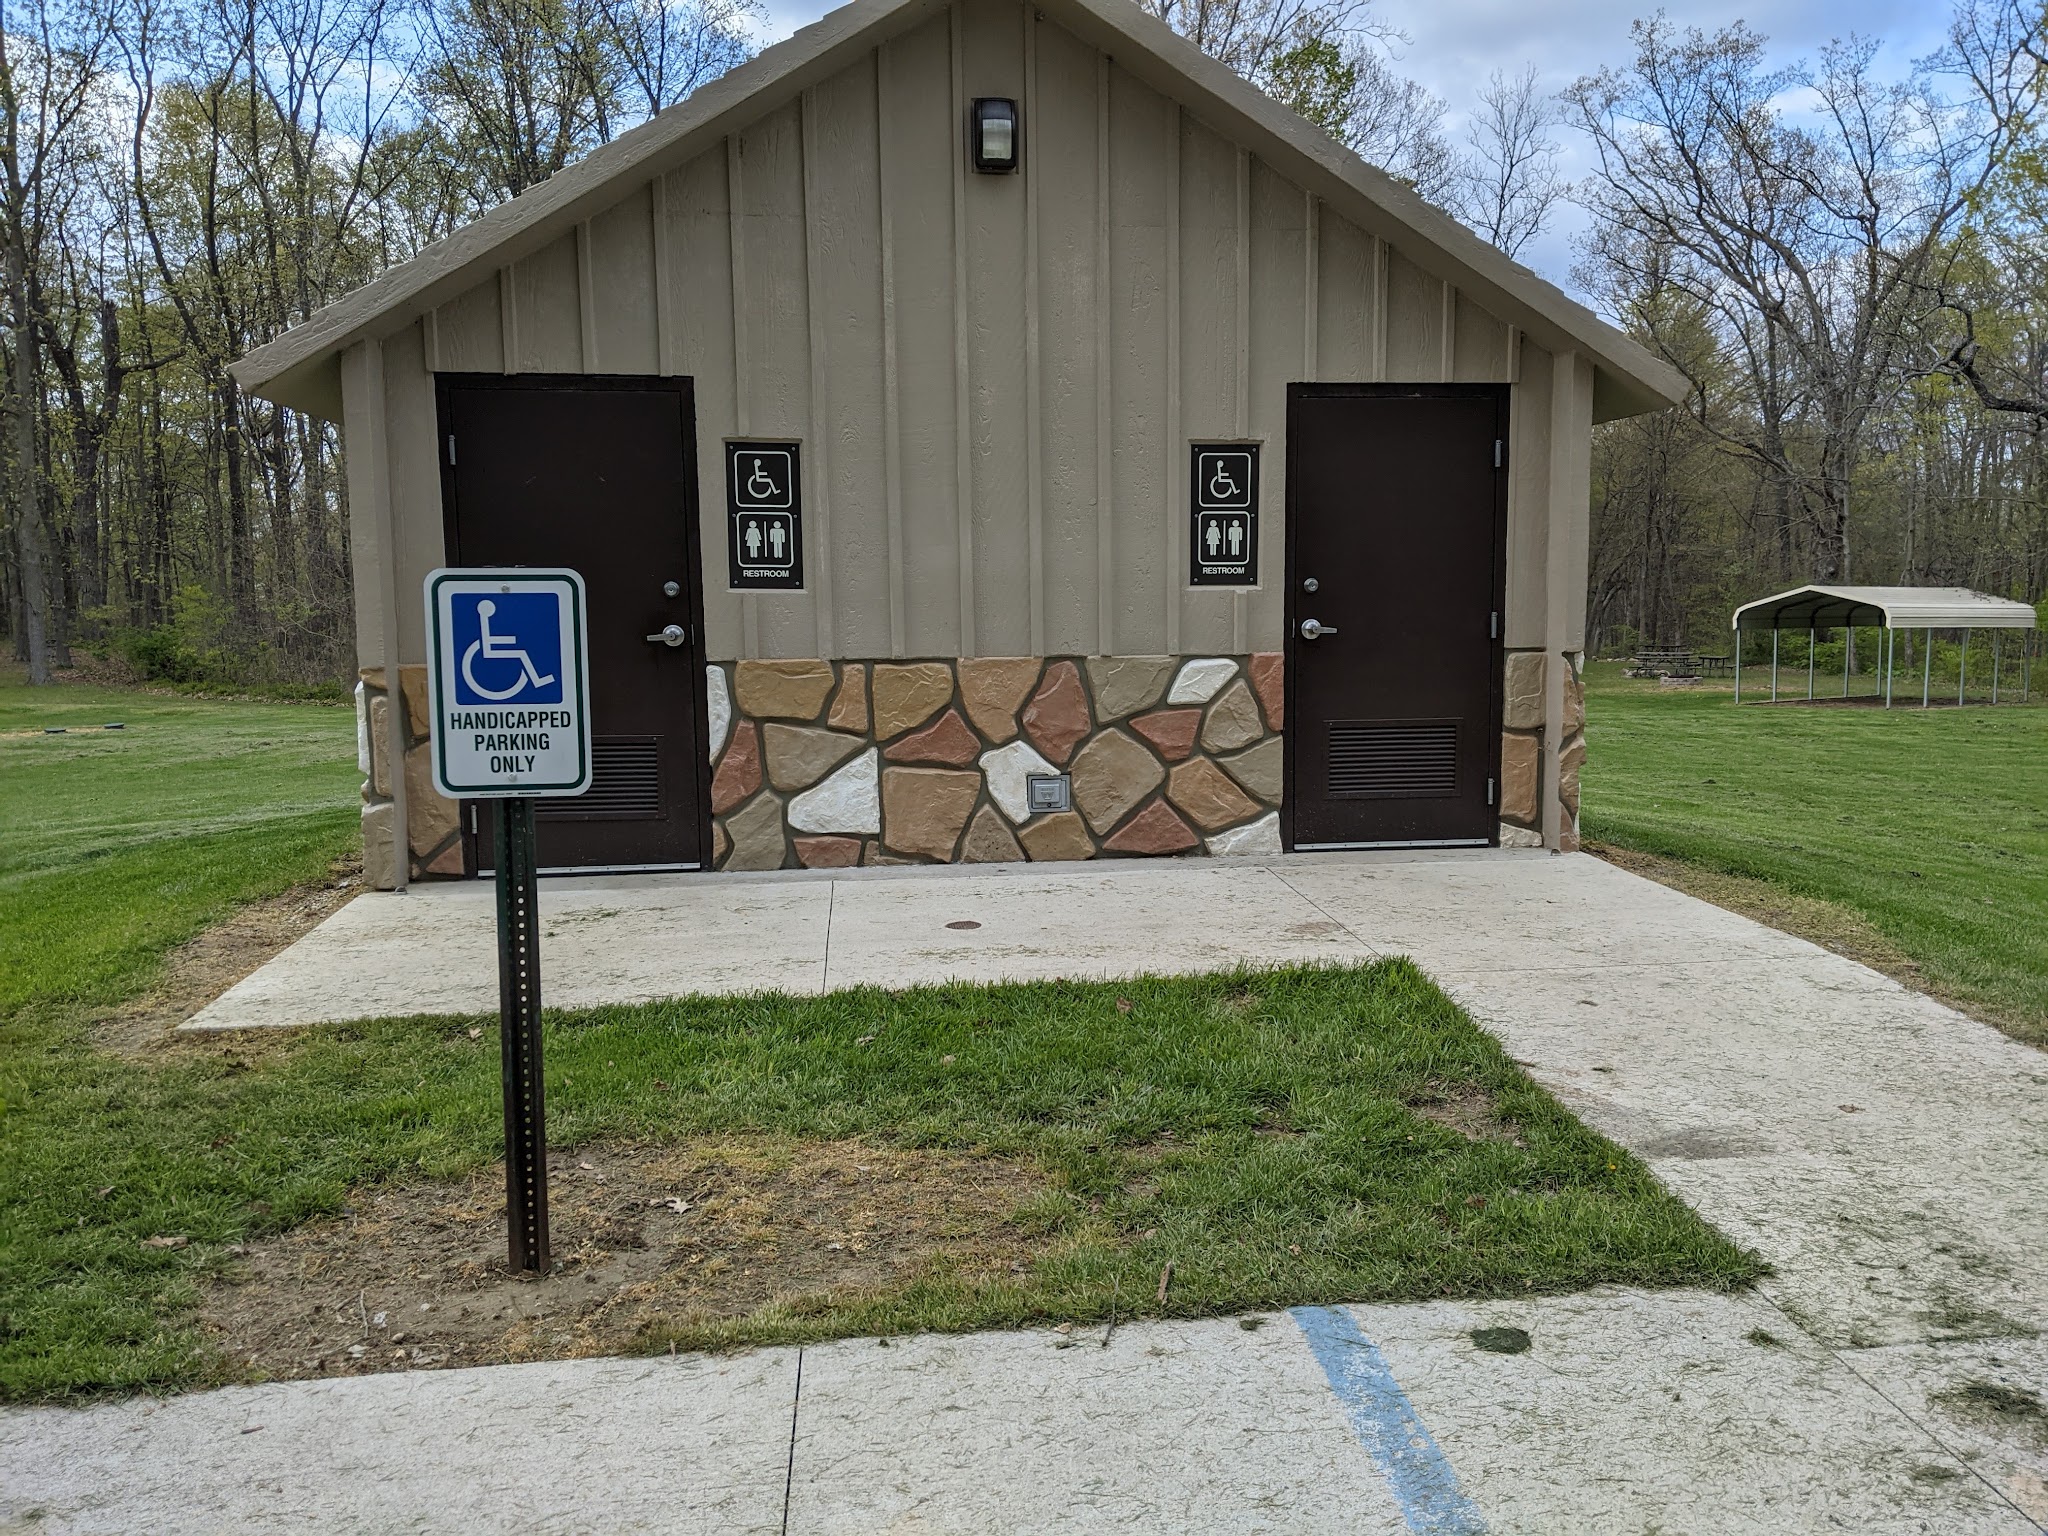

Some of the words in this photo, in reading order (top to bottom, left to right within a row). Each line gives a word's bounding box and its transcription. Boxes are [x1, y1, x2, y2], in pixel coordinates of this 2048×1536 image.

[743, 570, 789, 578] RESTROOM
[1202, 567, 1245, 575] RESTROOM
[450, 711, 571, 730] HANDICAPPED
[474, 733, 550, 751] PARKING
[490, 755, 536, 773] ONLY
